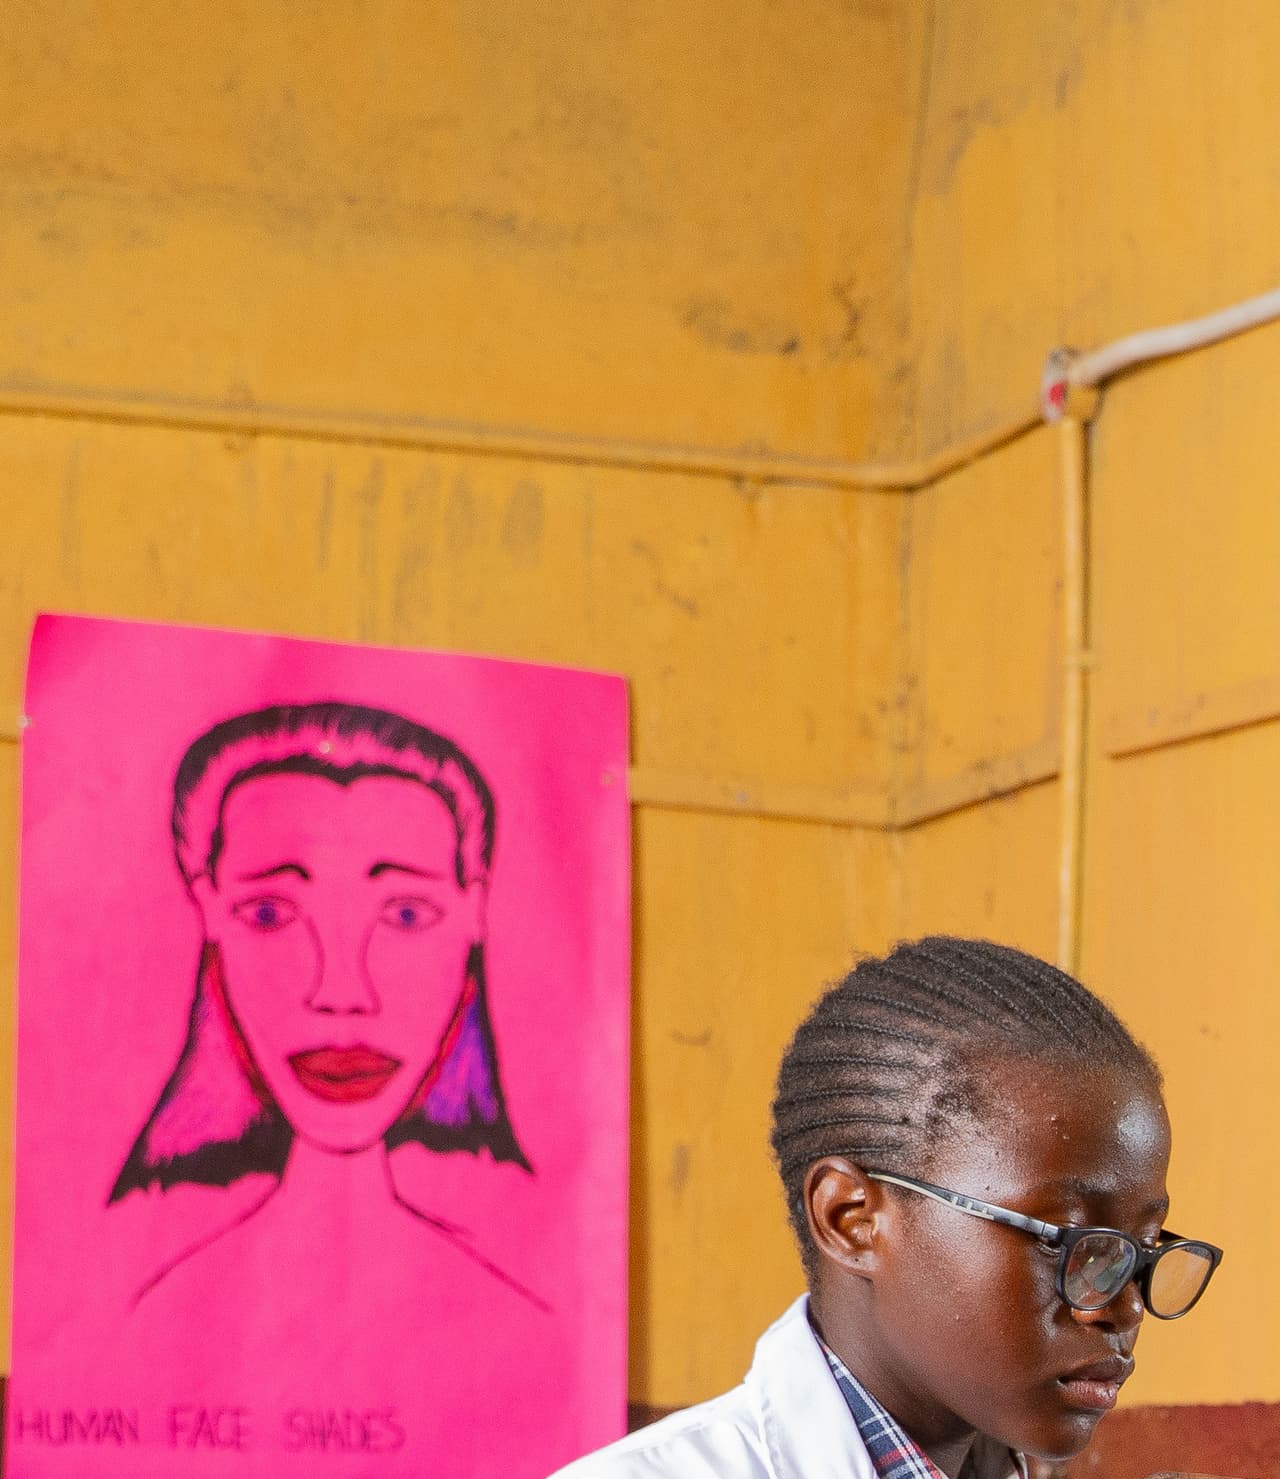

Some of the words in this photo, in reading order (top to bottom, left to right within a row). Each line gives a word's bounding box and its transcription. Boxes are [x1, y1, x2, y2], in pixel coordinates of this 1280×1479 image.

[16, 1406, 139, 1448] HUMAN
[167, 1403, 248, 1451] FACE
[285, 1406, 408, 1453] SHADES
